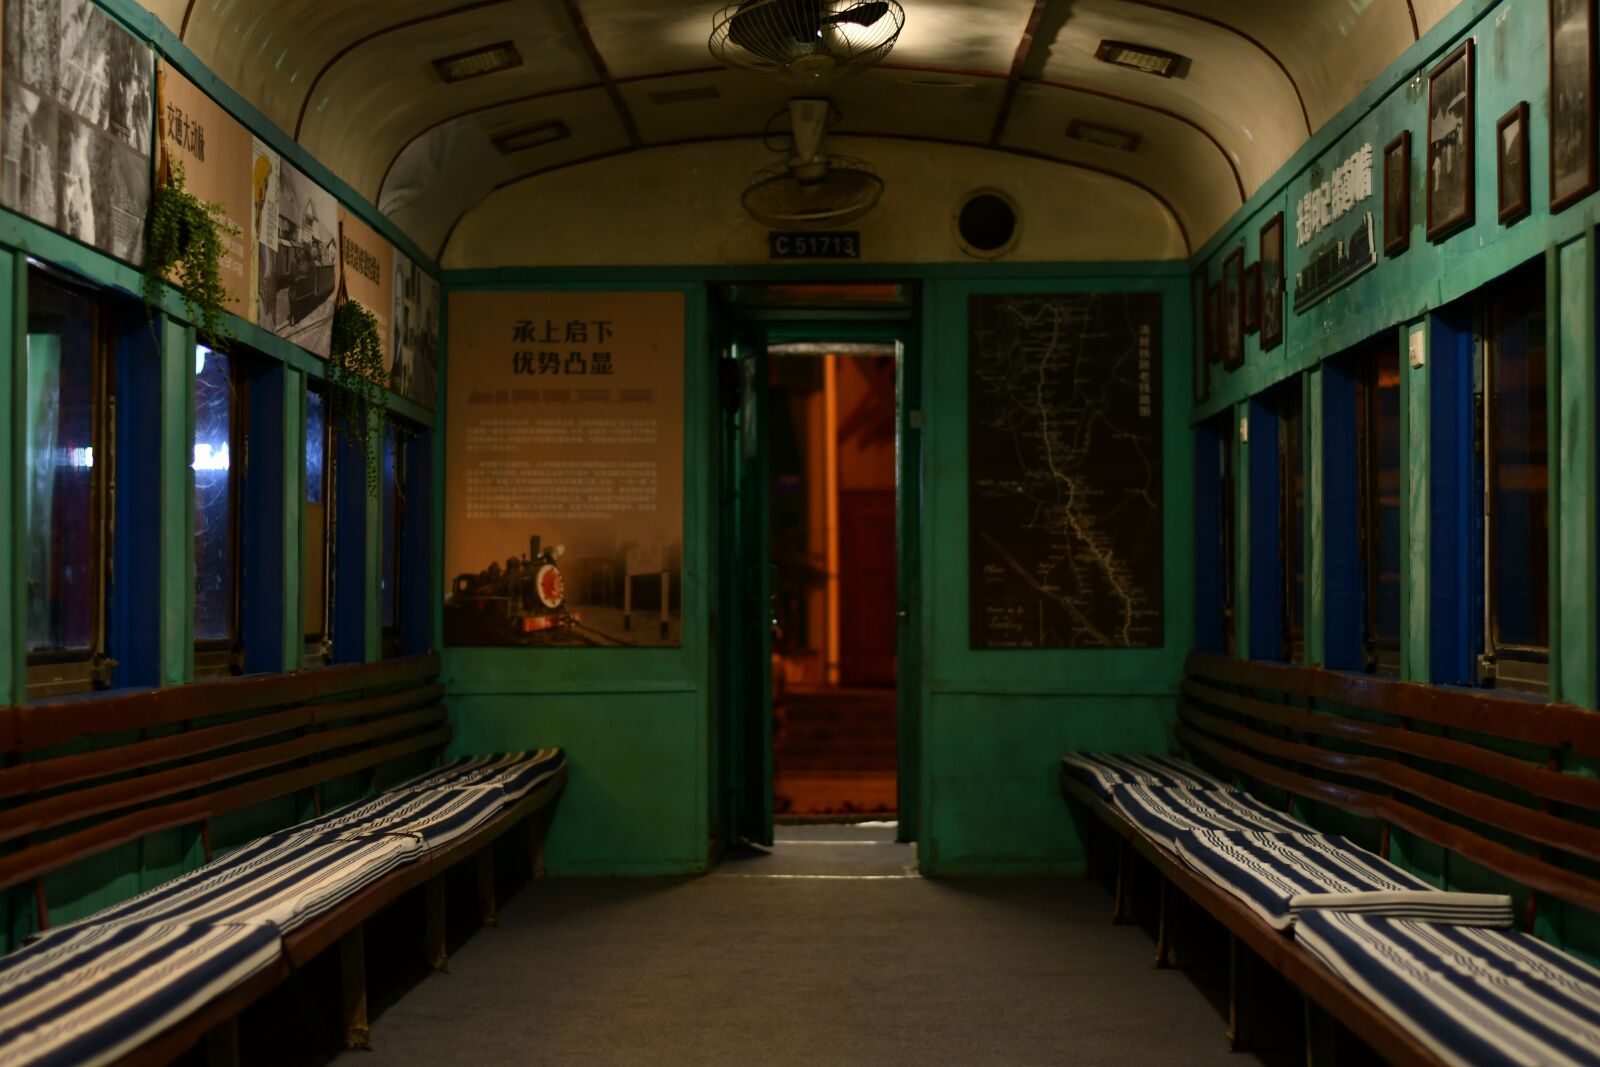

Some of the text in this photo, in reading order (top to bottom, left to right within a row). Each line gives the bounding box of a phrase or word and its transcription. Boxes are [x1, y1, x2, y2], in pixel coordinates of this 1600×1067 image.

[775, 235, 790, 255] C
[511, 319, 614, 344] 承上启下
[511, 351, 614, 375] 优势凸显
